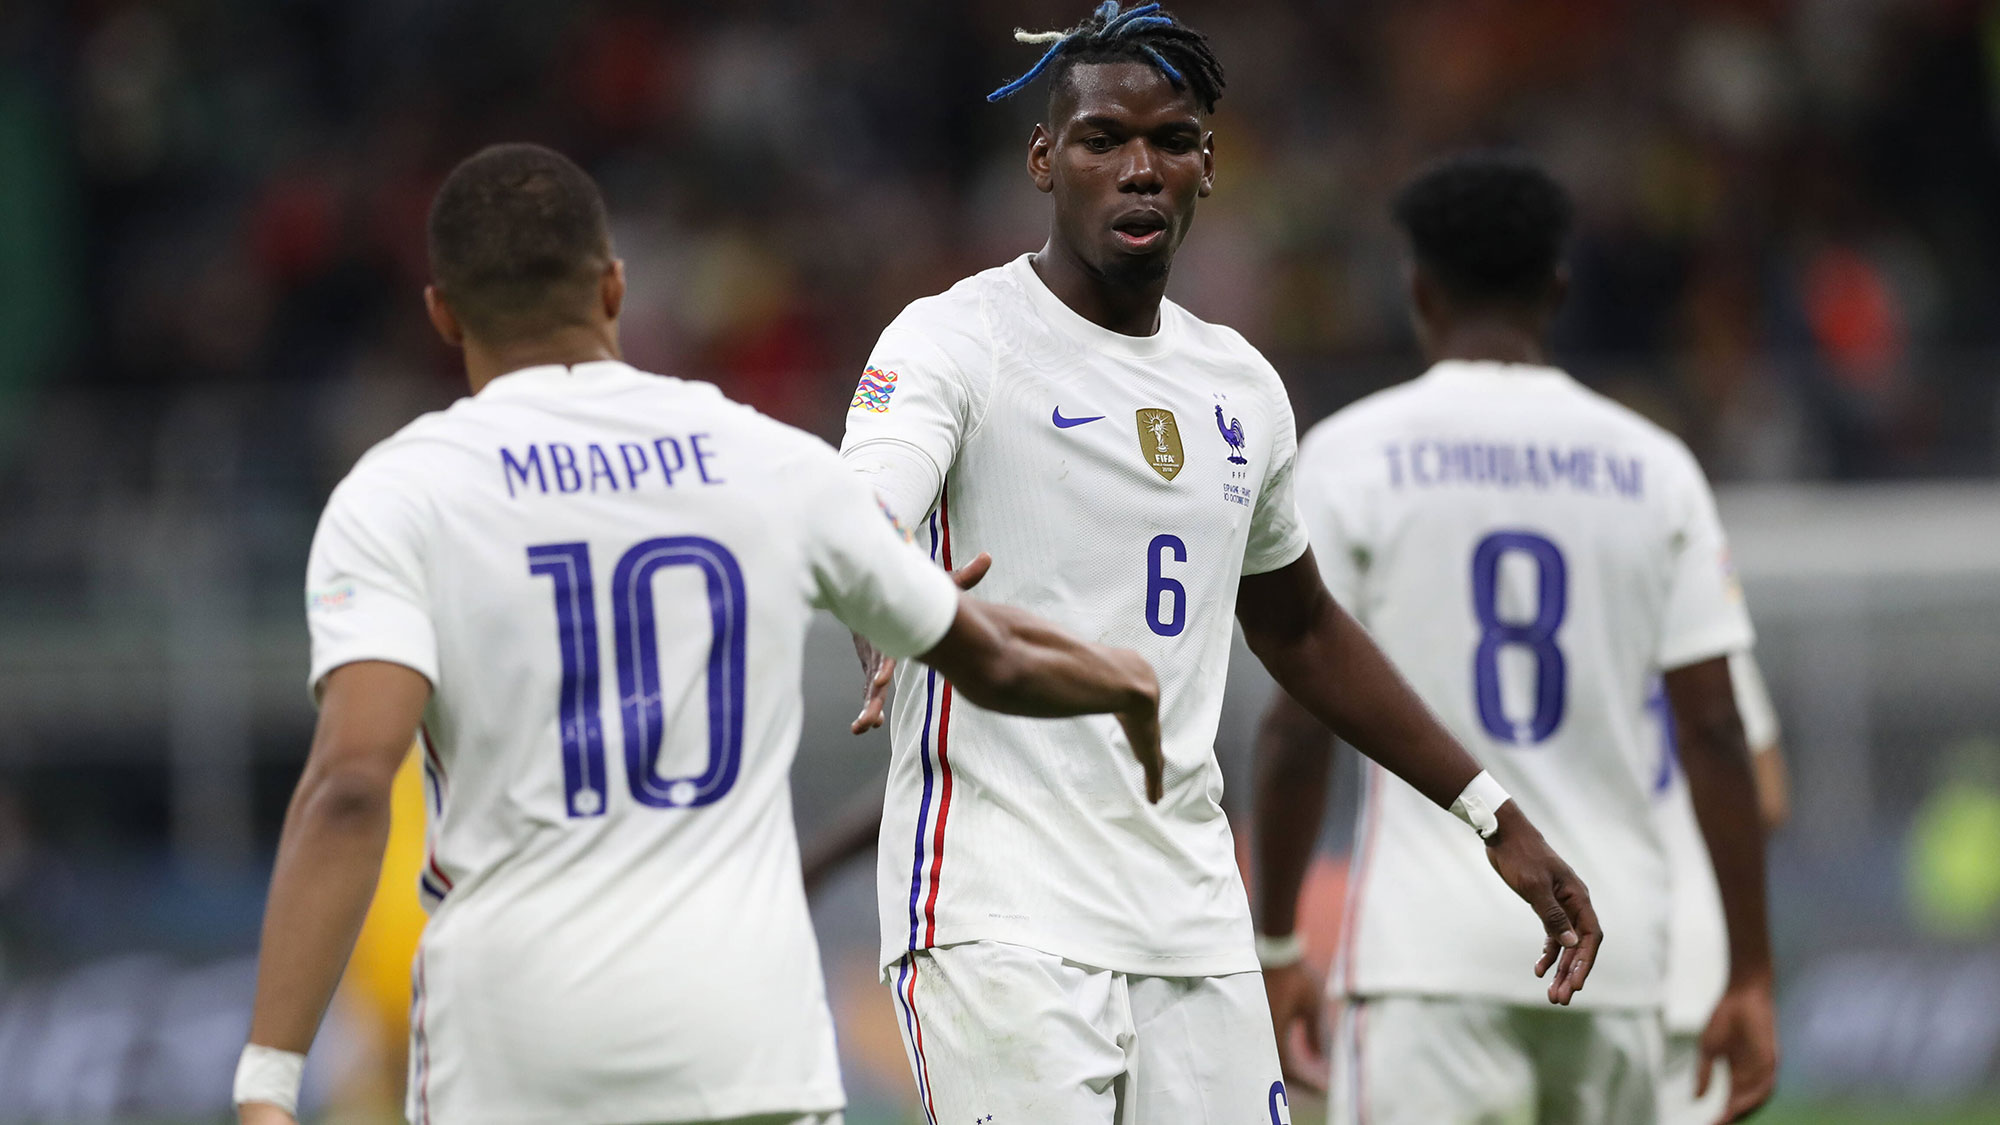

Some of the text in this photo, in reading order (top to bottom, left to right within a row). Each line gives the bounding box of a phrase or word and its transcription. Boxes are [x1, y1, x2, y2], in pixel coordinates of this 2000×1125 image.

[499, 433, 726, 499] MBAPPE
[1154, 454, 1175, 464] FIFA
[1145, 534, 1187, 637] 6
[1471, 529, 1566, 744] 8
[526, 535, 747, 818] 10
